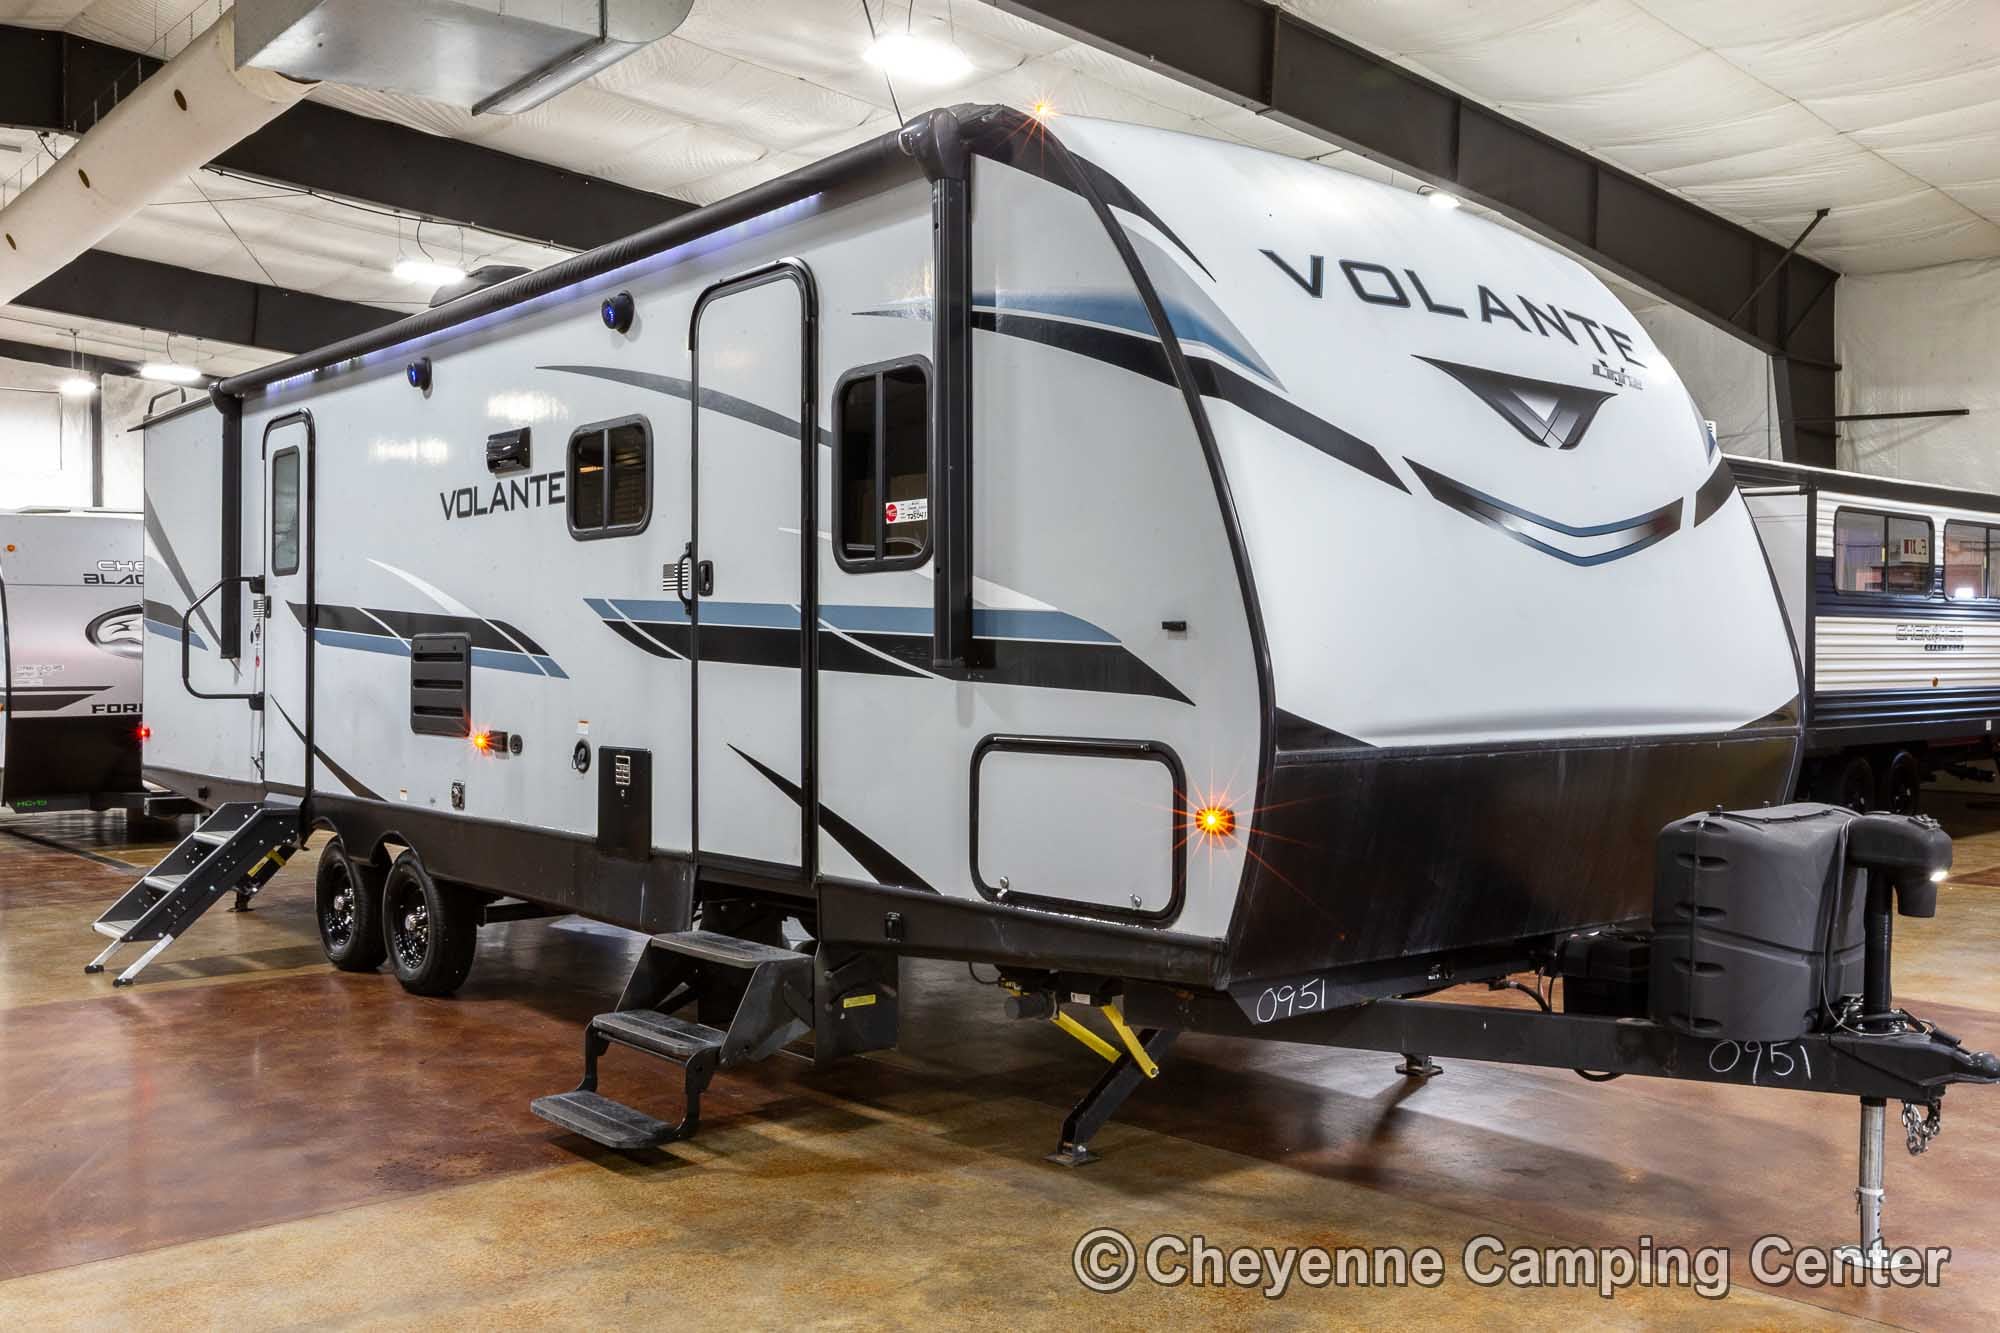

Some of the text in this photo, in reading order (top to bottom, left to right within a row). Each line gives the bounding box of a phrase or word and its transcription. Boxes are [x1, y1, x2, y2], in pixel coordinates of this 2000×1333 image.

[1257, 249, 1648, 368] VOLANTE
[440, 471, 565, 520] VOLANTE
[1257, 978, 1325, 1022] 0951
[1709, 1040, 1811, 1084] 0951
